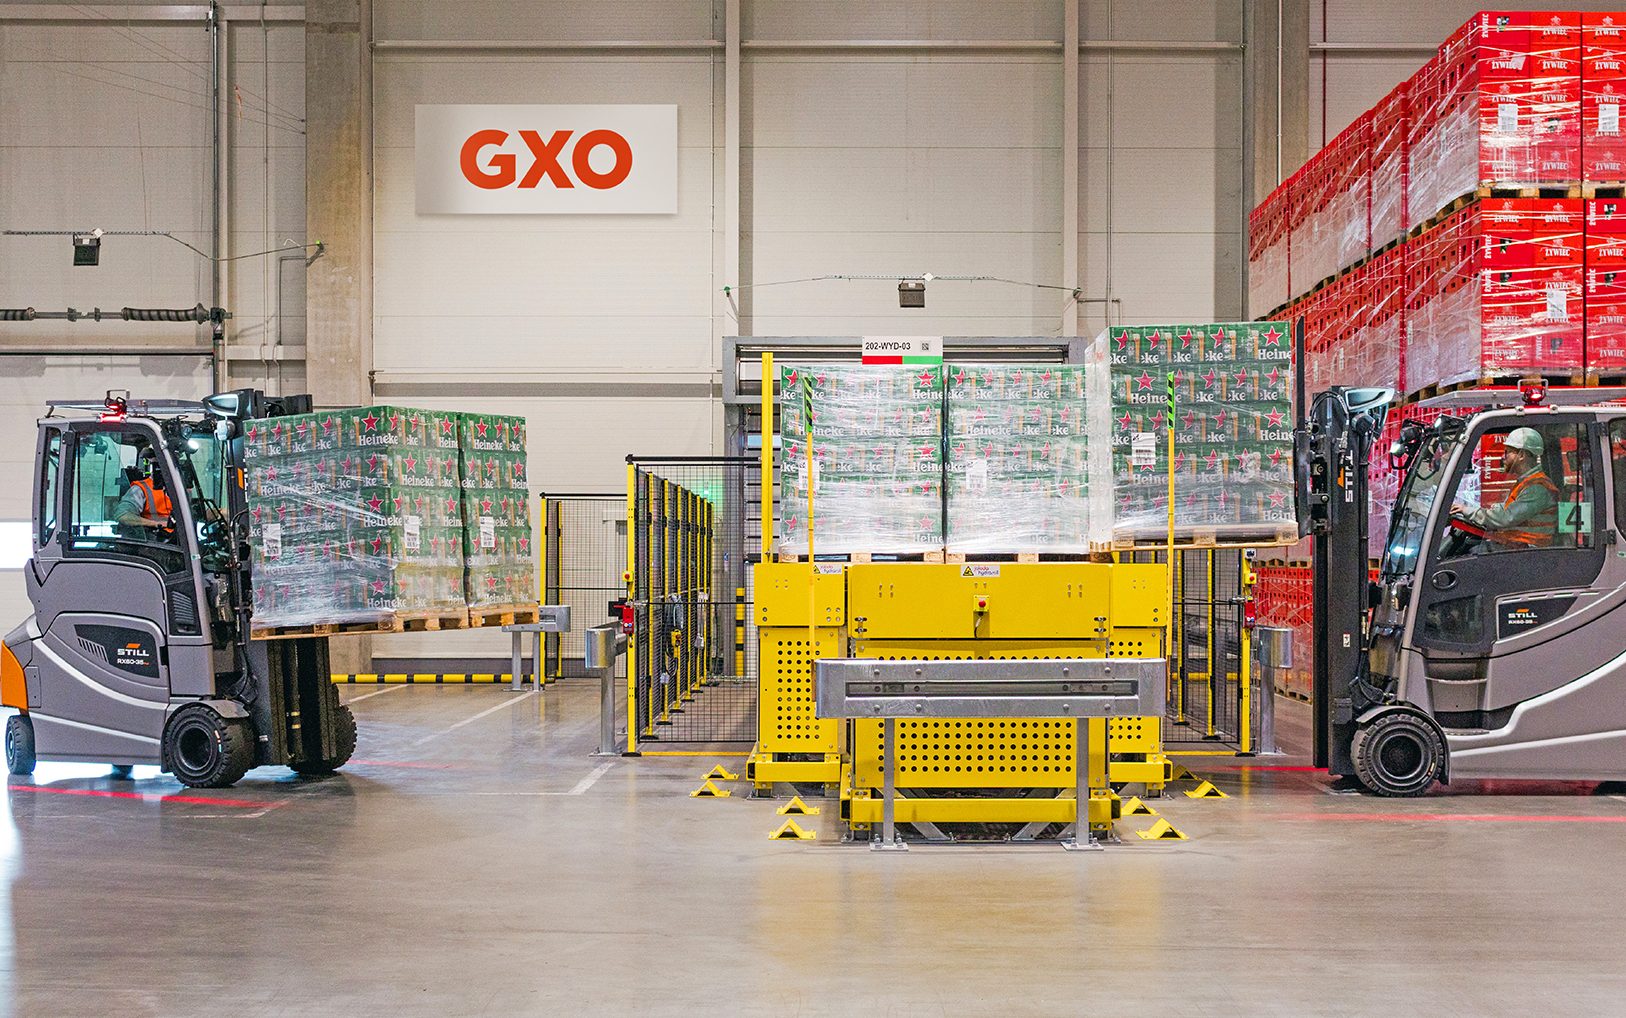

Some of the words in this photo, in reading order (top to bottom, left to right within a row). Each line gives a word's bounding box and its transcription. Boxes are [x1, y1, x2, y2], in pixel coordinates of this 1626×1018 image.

[460, 129, 633, 190] GXO
[865, 342, 911, 350] 202-WYD-03
[1566, 505, 1584, 530] 4
[118, 648, 149, 656] STILL
